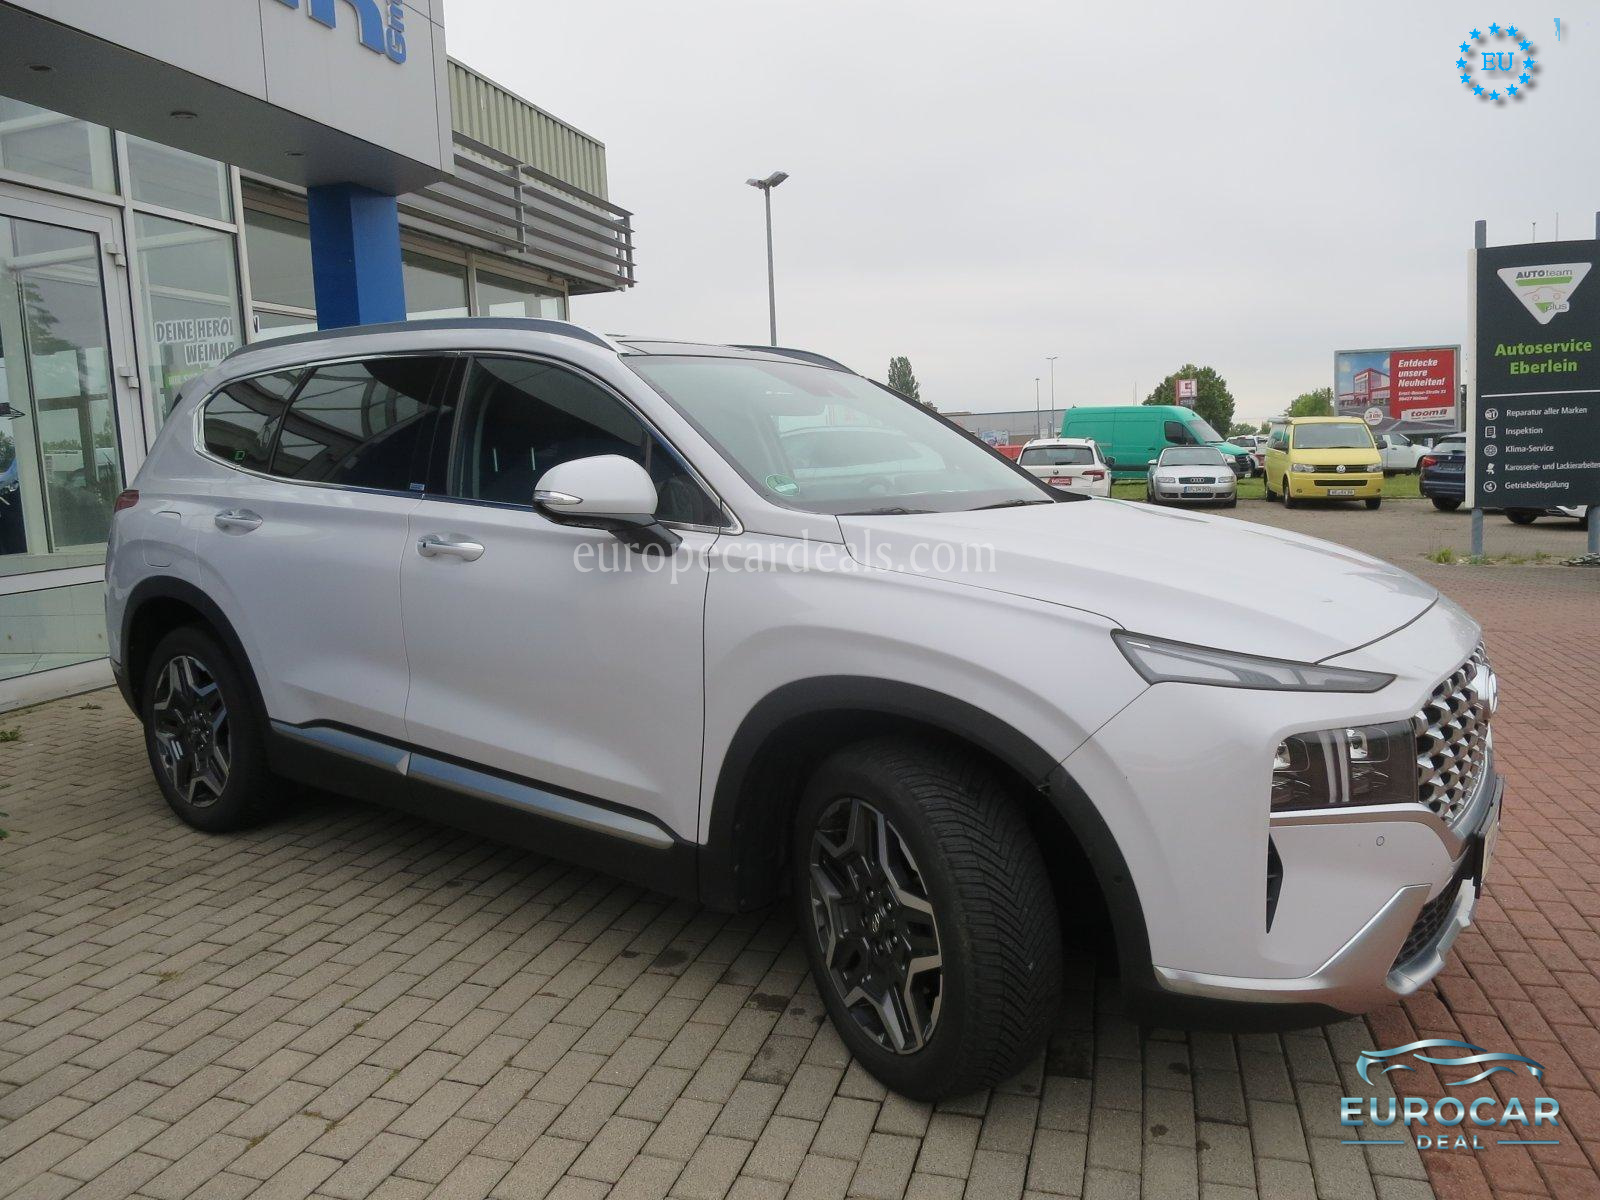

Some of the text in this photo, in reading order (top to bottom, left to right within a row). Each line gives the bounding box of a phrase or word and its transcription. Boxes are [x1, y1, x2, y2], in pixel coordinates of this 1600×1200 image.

[1516, 268, 1573, 279] AUTOteam
[1545, 302, 1568, 313] plus
[155, 321, 193, 342] DEINE
[1494, 339, 1593, 356] Autoservice
[1398, 359, 1438, 368] Entdecke
[1510, 358, 1578, 375] Eberlein
[1398, 370, 1428, 378] unsere
[1398, 377, 1446, 387] Neuheiten!
[1411, 409, 1439, 417] toom
[1506, 406, 1588, 418] Reparatur aller Marken
[1505, 427, 1543, 436] Inspektion
[1505, 444, 1554, 453] Klima-Service
[1505, 463, 1541, 471] Karosserie-
[1542, 462, 1555, 470] und
[1505, 481, 1570, 490] Getriebeölspülung
